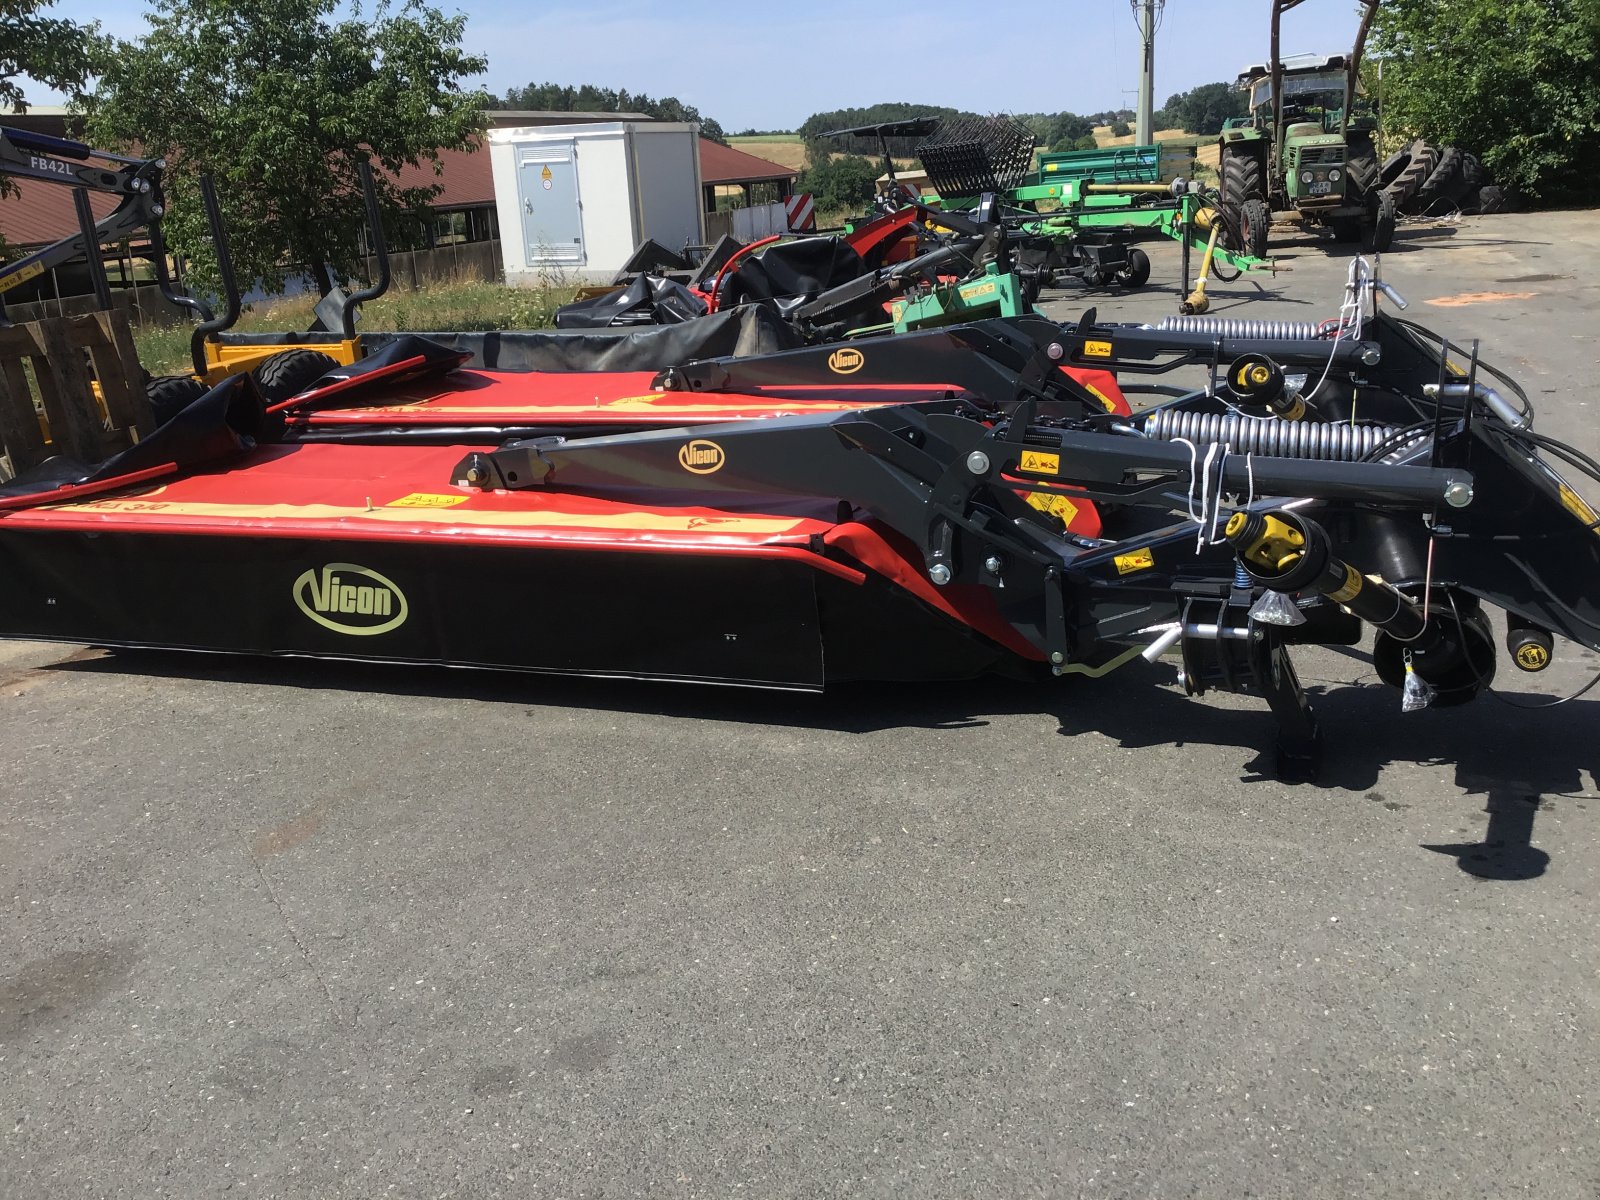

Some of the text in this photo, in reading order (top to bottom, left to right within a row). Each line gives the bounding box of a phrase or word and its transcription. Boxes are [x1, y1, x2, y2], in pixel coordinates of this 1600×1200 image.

[31, 156, 73, 175] FB42L
[831, 349, 859, 368] Vicon
[682, 440, 718, 465] Vicon
[303, 563, 391, 615] Vicon
